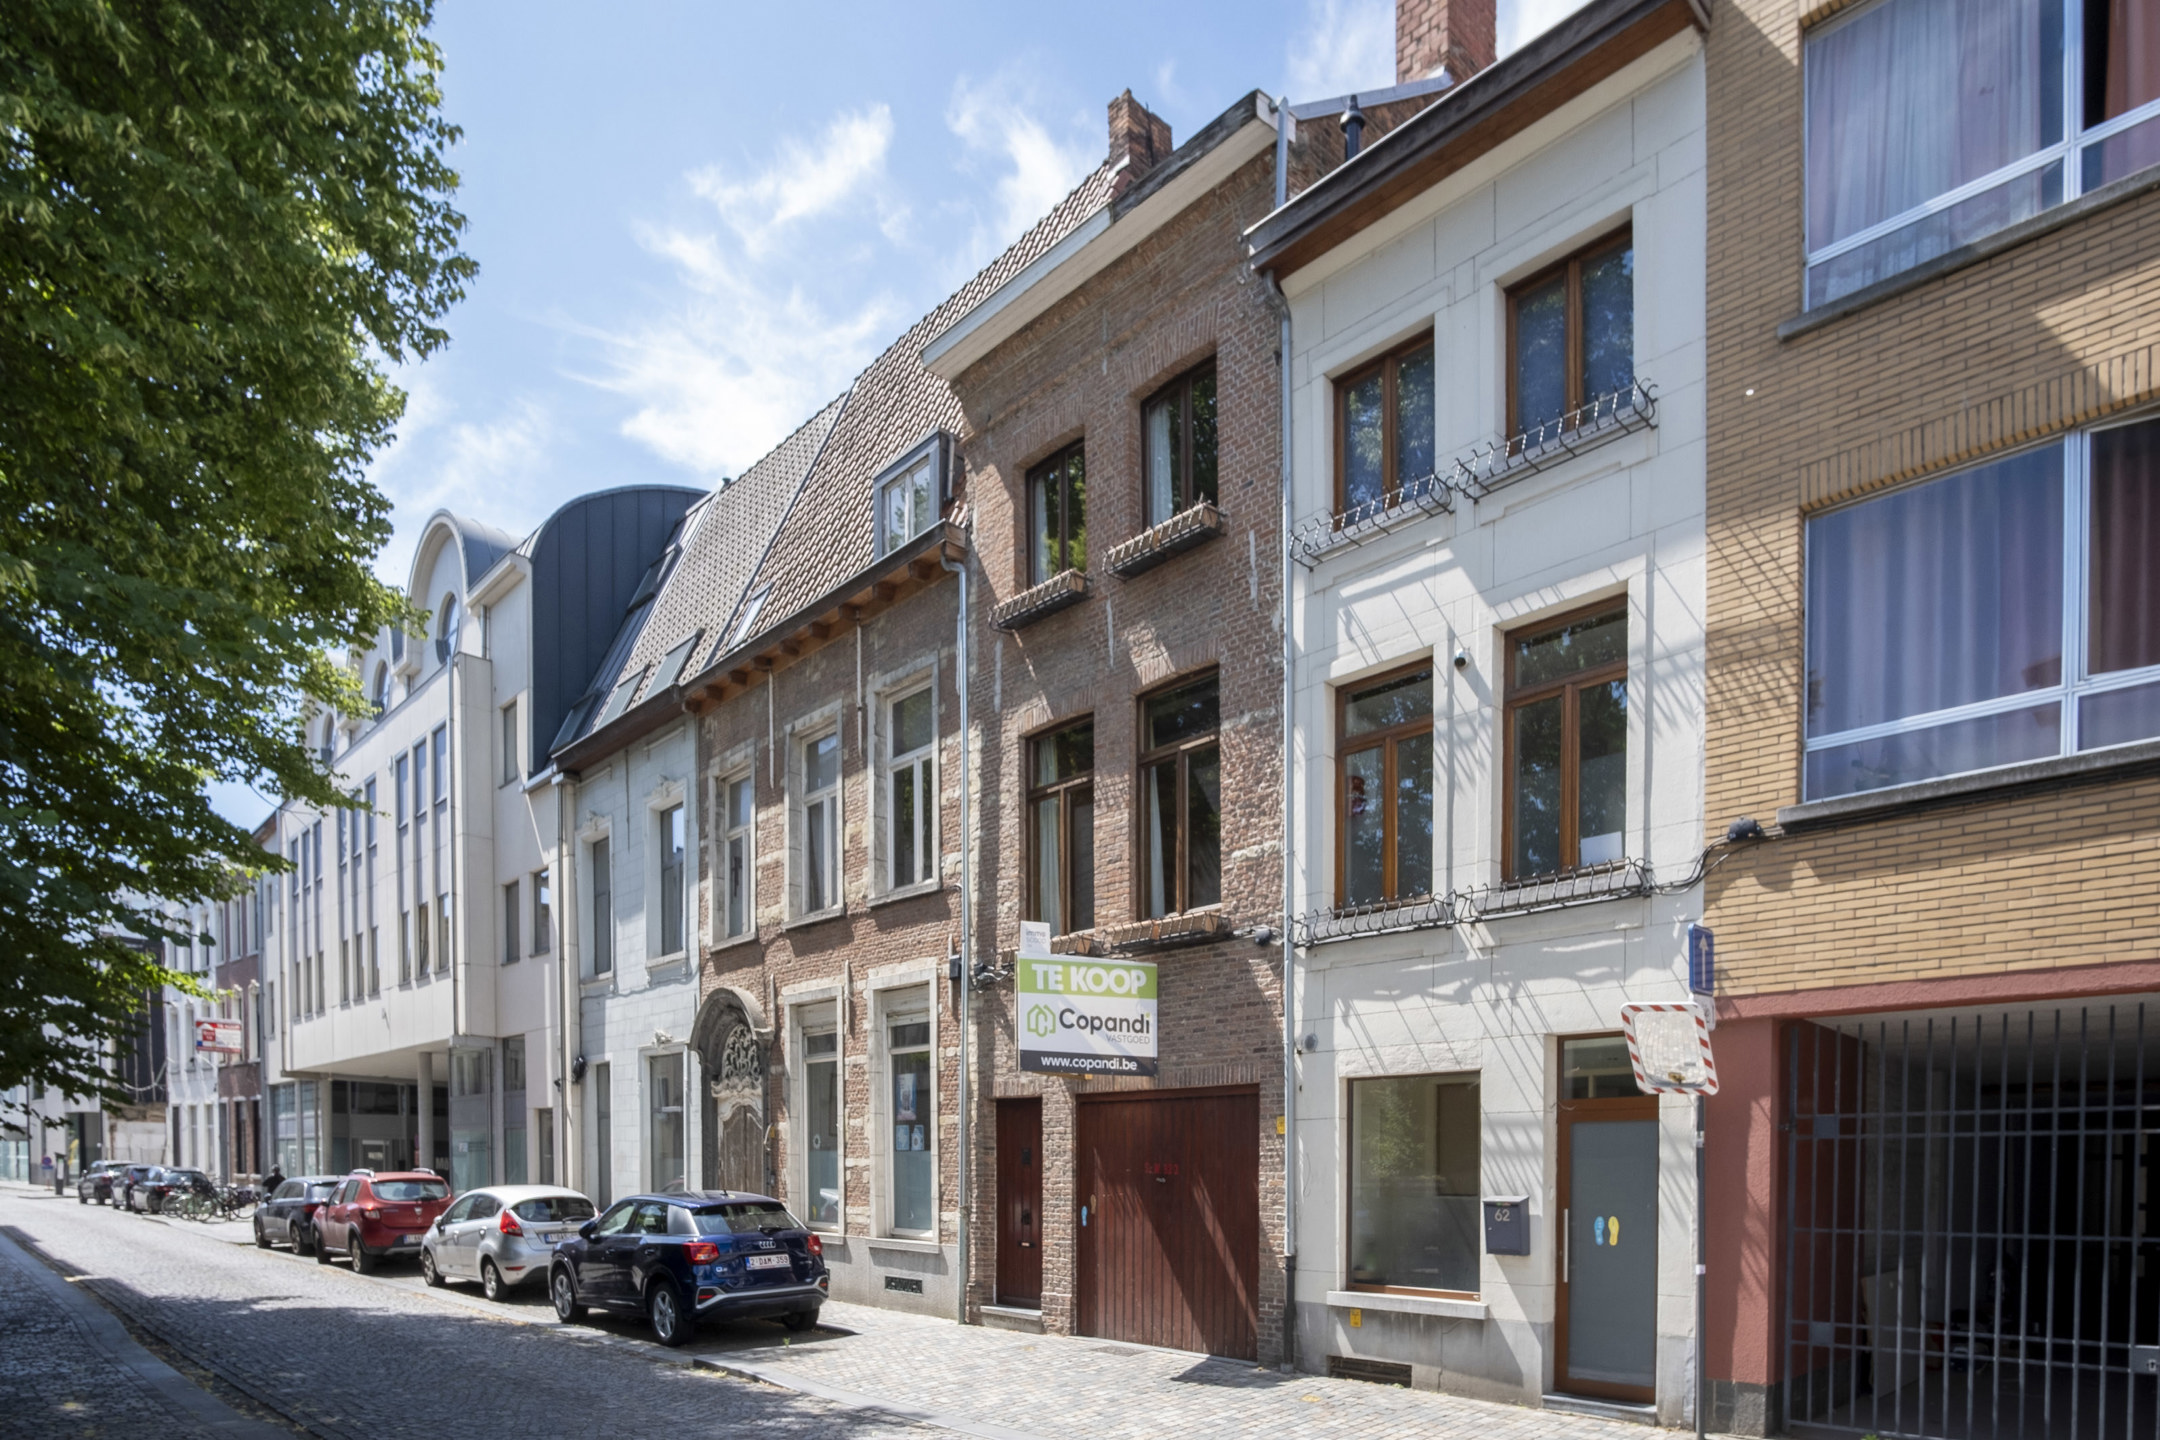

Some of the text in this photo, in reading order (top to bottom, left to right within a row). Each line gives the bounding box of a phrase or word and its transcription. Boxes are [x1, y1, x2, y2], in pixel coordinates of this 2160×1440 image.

[1031, 964, 1147, 994] TE KOOP
[1059, 1008, 1151, 1035] Copandi
[1106, 1034, 1151, 1045] VASTGOED
[1041, 1056, 1138, 1071] www.copandi.be
[1495, 1208, 1510, 1222] 62
